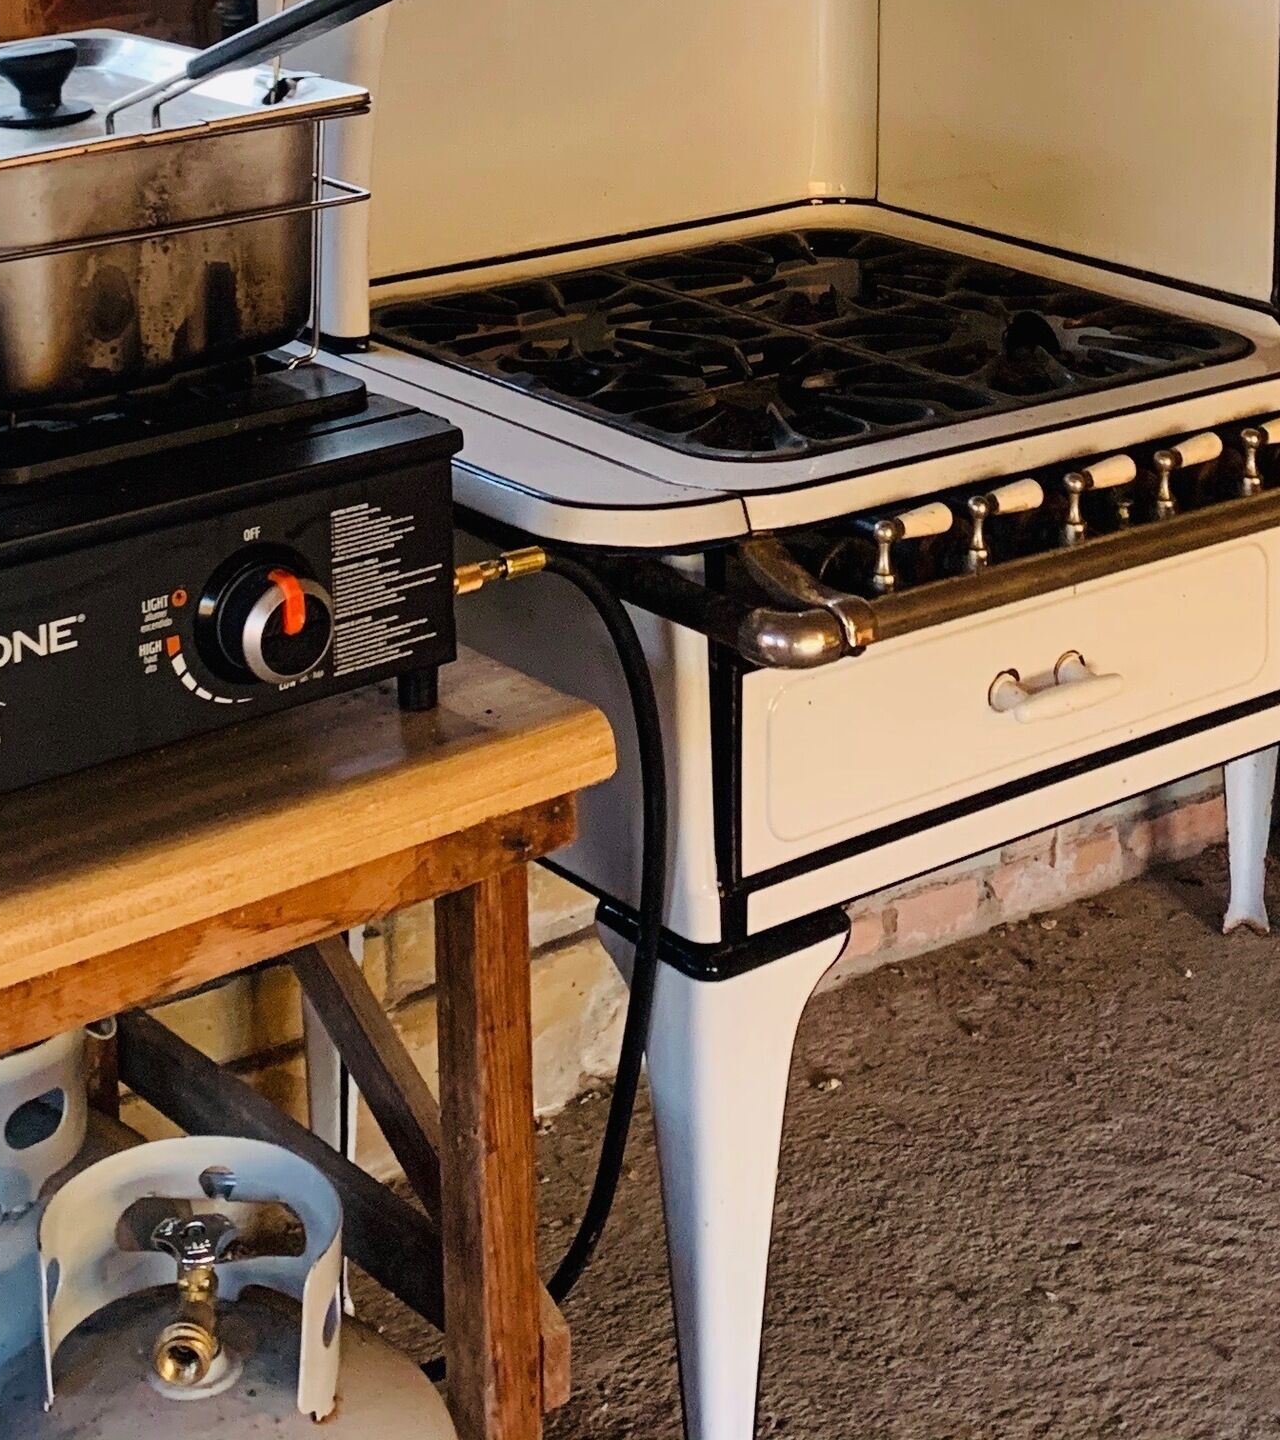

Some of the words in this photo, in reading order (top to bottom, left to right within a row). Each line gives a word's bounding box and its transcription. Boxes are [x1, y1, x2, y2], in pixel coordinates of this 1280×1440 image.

[243, 525, 261, 542] OFF
[141, 594, 170, 614] LIGHT
[138, 639, 162, 657] HIGH
